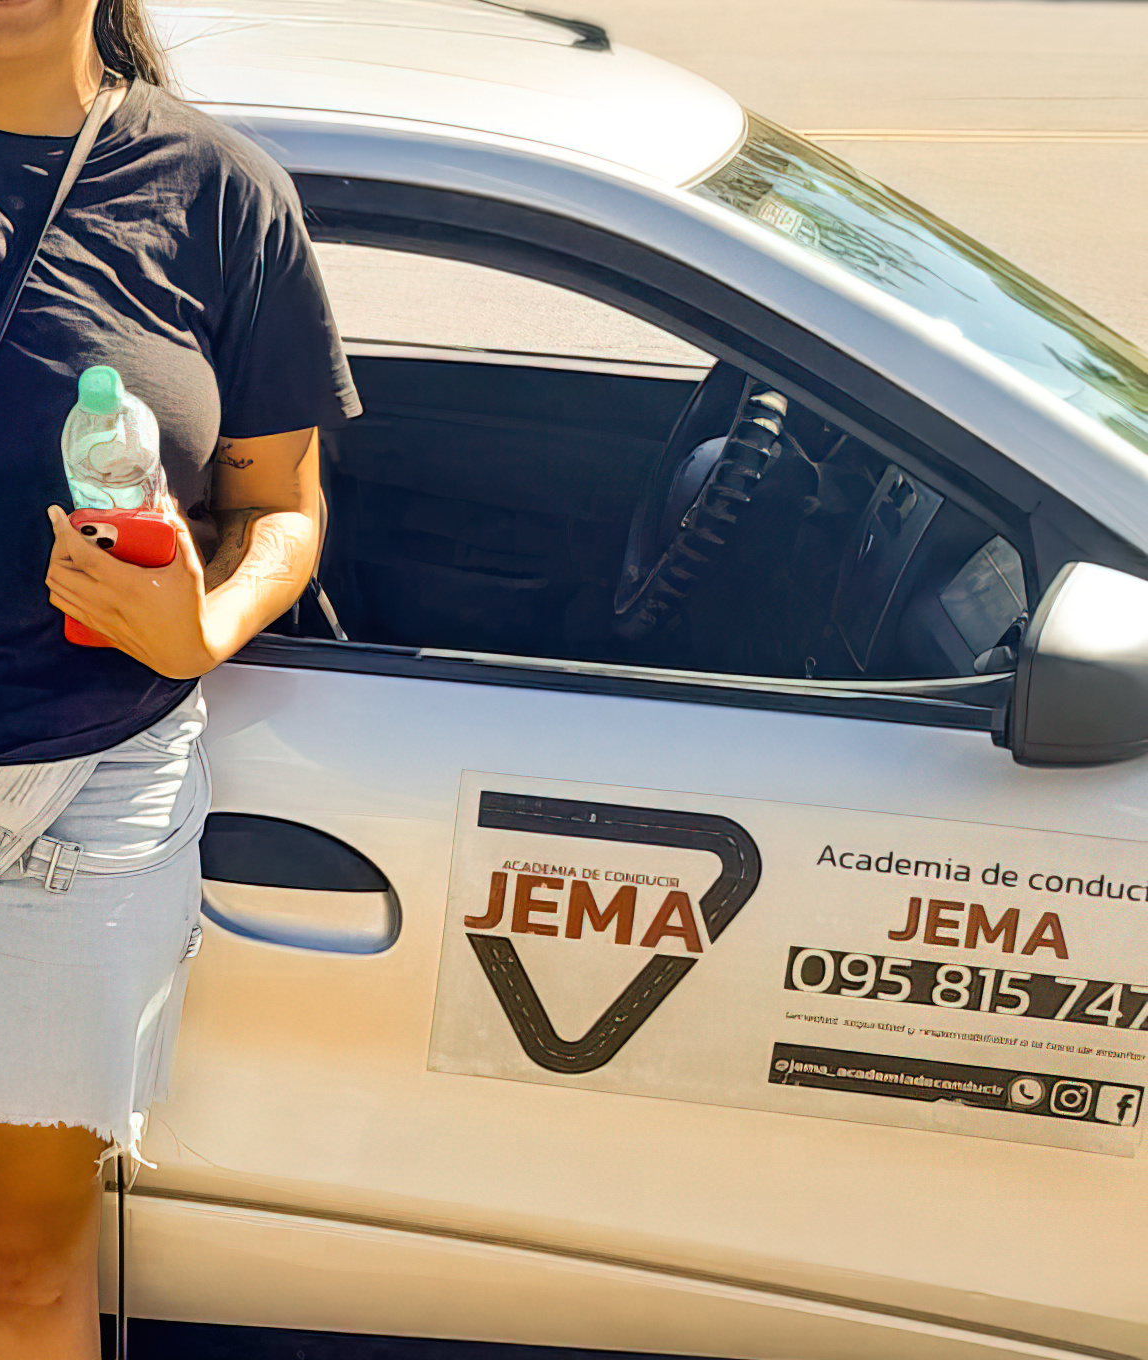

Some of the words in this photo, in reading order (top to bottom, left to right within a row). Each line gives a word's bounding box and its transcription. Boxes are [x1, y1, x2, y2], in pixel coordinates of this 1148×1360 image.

[502, 860, 577, 878] ACADEMIA
[582, 868, 601, 880] DE
[817, 845, 970, 882] Academia
[981, 863, 1018, 887] de
[464, 871, 703, 953] JEMA
[888, 897, 1069, 960] JEMA
[791, 948, 912, 1002] 095
[931, 963, 1032, 1015] 815
